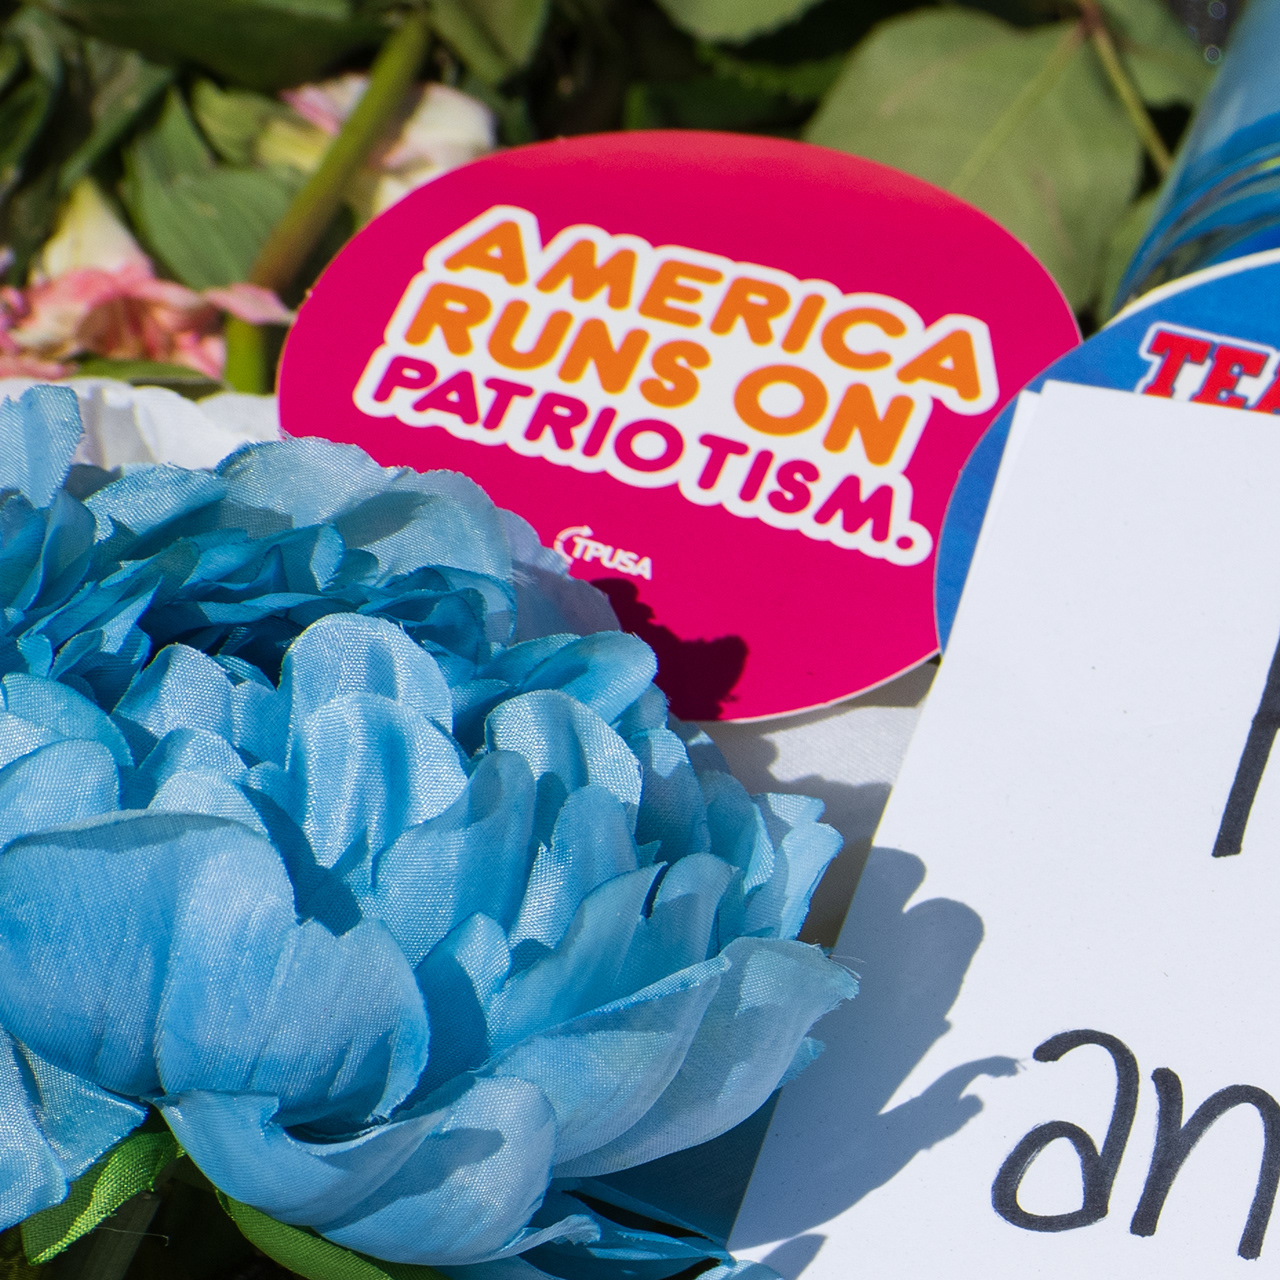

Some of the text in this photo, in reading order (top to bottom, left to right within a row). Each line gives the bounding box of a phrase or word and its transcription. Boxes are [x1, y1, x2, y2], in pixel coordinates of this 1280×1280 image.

[403, 281, 915, 466] RUNS ON
[443, 220, 984, 401] AMERICA
[372, 356, 916, 551] PATRIOTISM.
[571, 536, 652, 581] TPUSA
